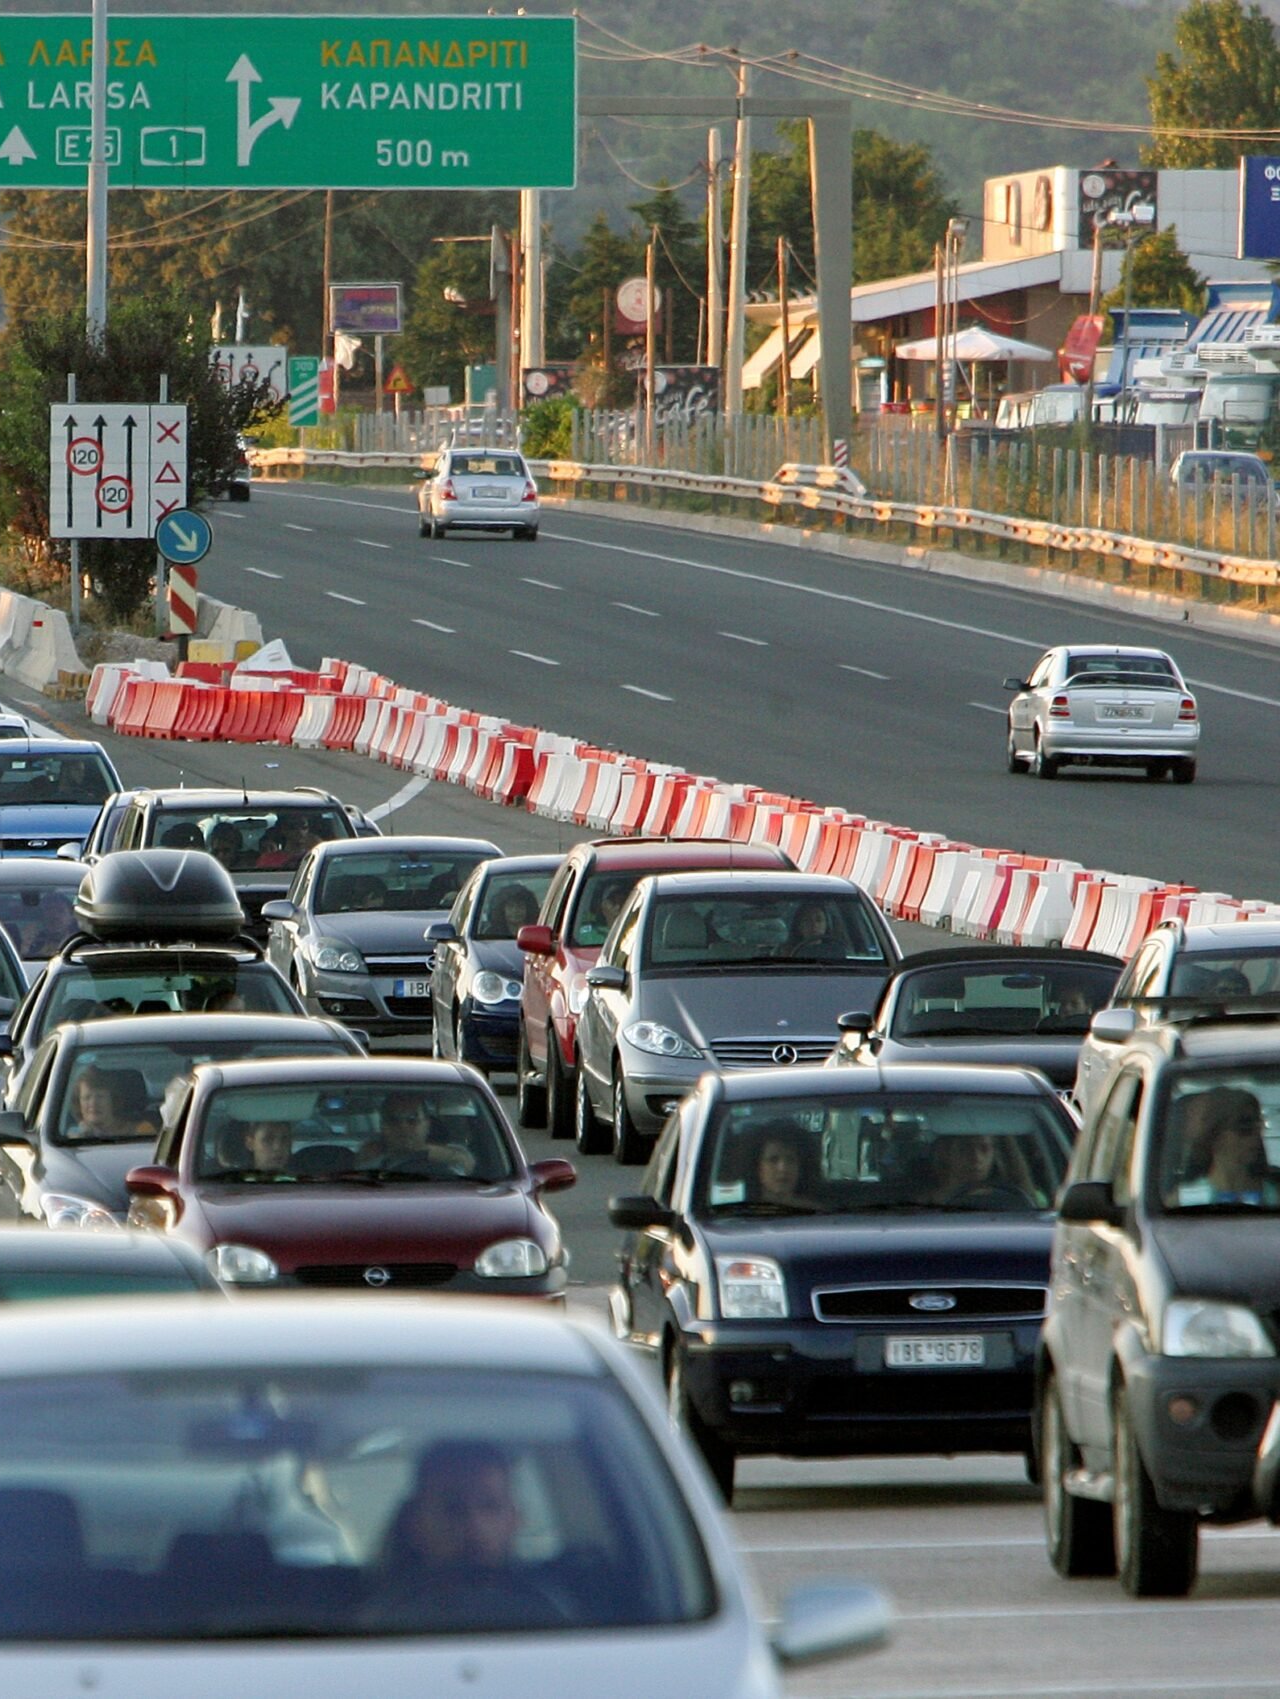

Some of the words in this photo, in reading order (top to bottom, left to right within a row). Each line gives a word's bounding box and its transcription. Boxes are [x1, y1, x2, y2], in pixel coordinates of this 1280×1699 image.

[321, 40, 528, 67] ΚΑΠΑΝΔΡΙΤΙ
[27, 81, 151, 109] LARSA
[321, 82, 522, 110] KAPANDRITI
[169, 135, 178, 158] 1
[376, 140, 433, 167] 500
[441, 150, 469, 167] m
[72, 449, 99, 465] 120
[102, 487, 128, 503] 120
